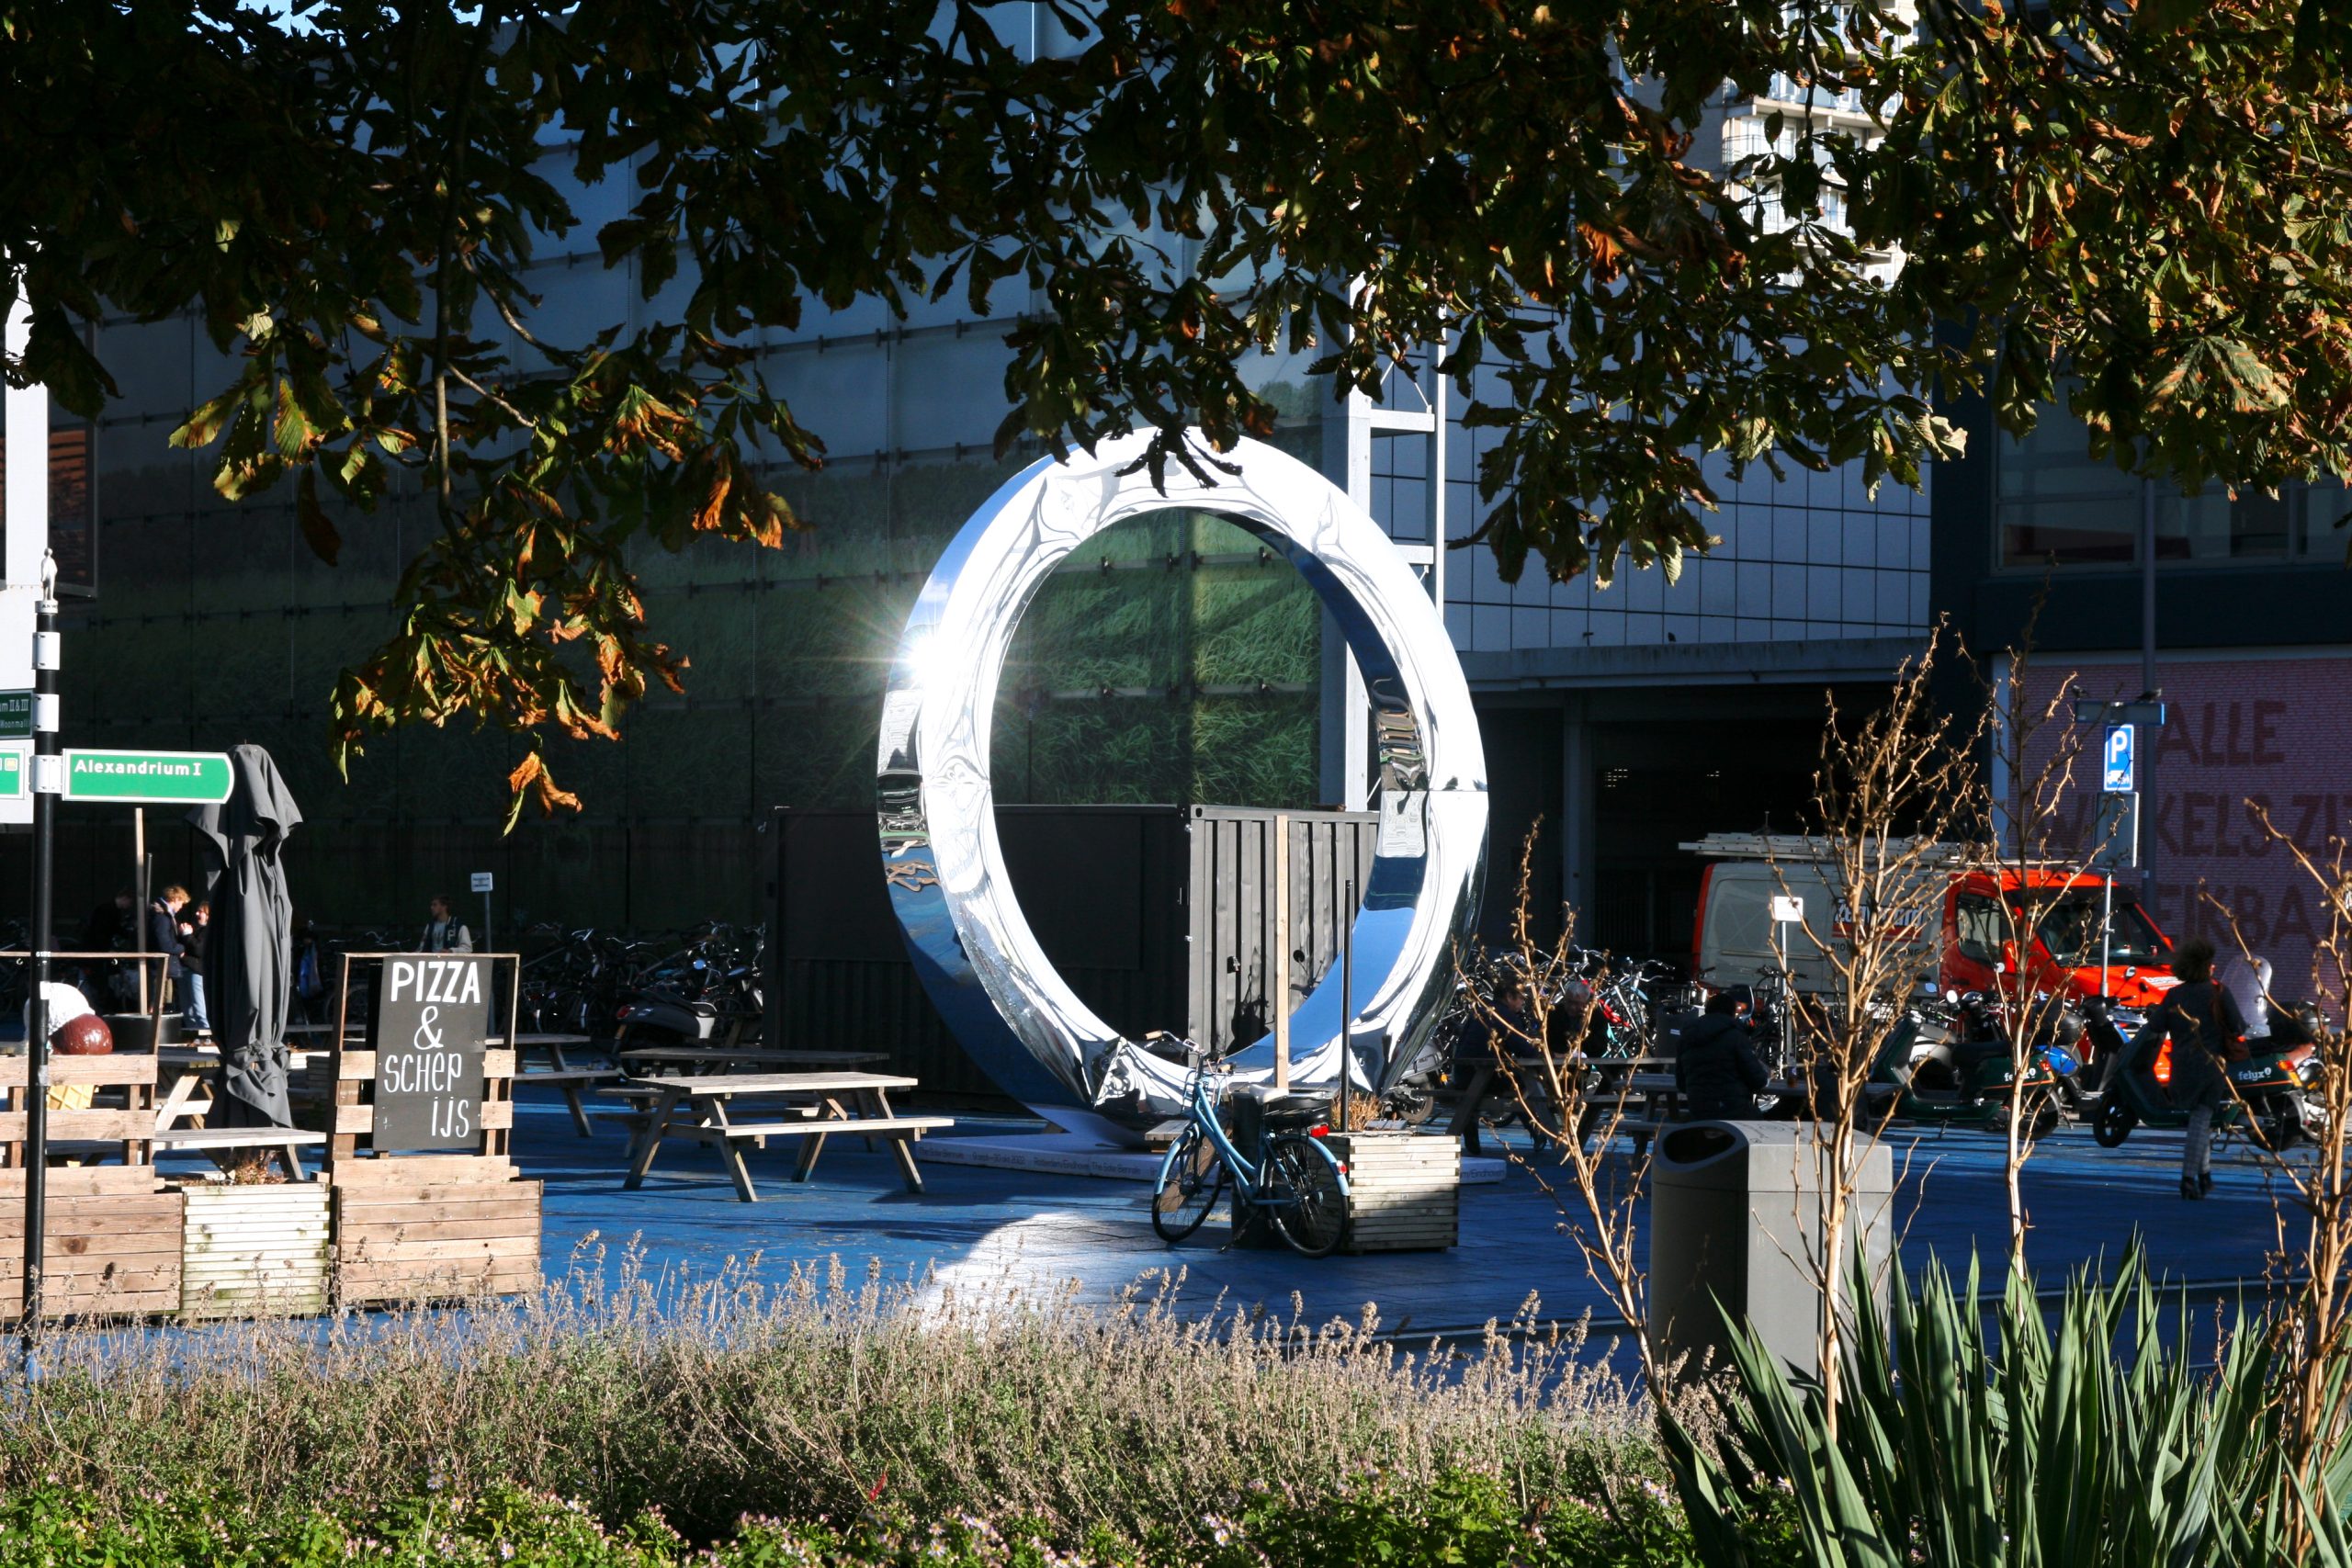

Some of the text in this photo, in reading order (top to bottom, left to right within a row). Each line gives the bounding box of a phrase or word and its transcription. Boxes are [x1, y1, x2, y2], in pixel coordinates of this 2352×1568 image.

[2111, 730, 2128, 764] P
[2154, 699, 2287, 765] ALLE
[74, 759, 190, 775] Alexandrium
[390, 960, 481, 1004] PIZZA
[413, 1005, 444, 1051] &
[2004, 1071, 2030, 1083] fex
[2238, 1068, 2265, 1081] felyx
